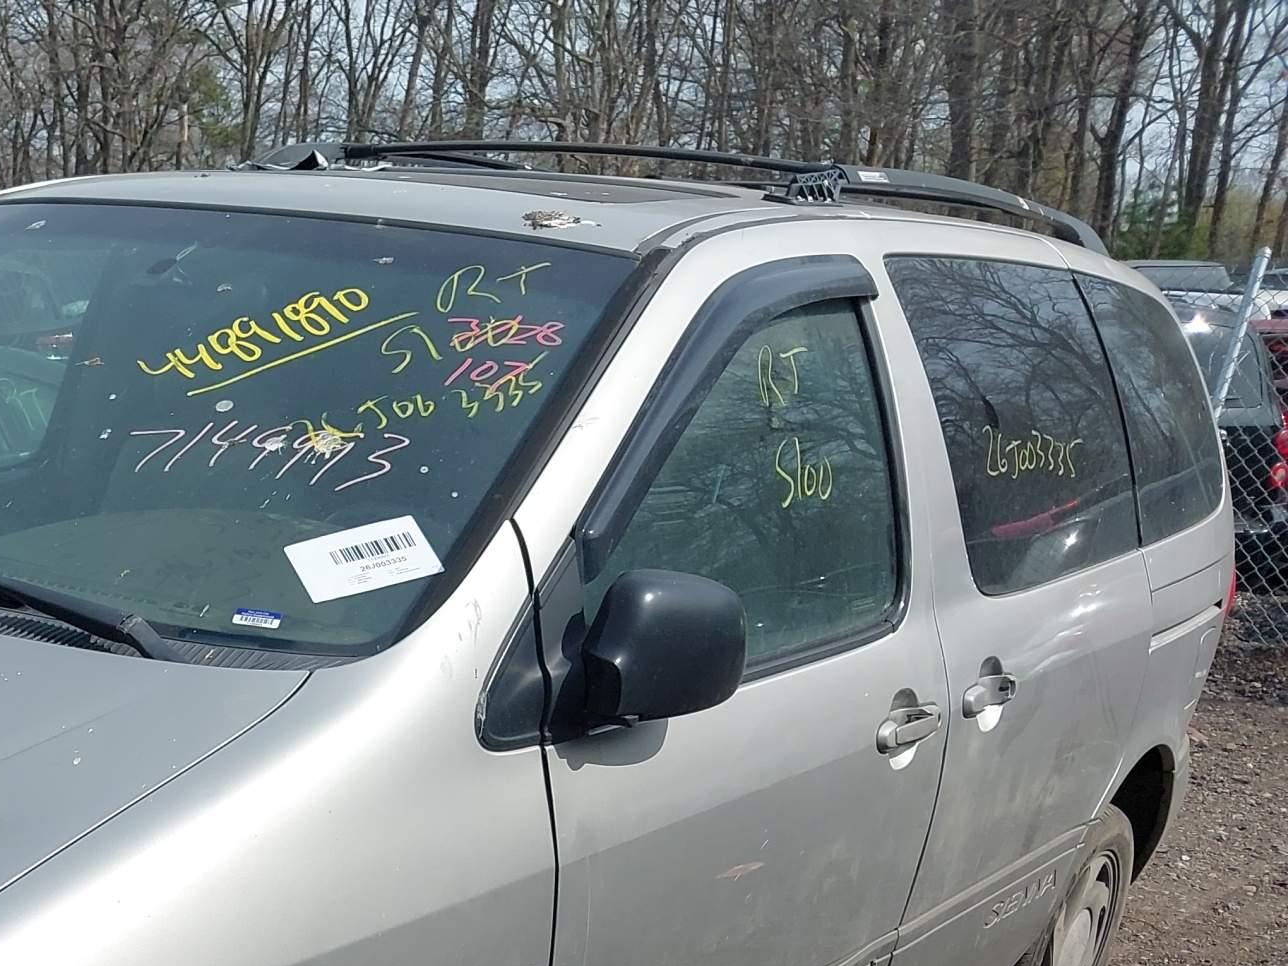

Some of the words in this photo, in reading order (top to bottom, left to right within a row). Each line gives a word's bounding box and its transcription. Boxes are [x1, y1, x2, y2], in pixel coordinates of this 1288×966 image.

[436, 262, 552, 313] RT
[137, 286, 370, 379] 44891890
[758, 345, 808, 407] RT
